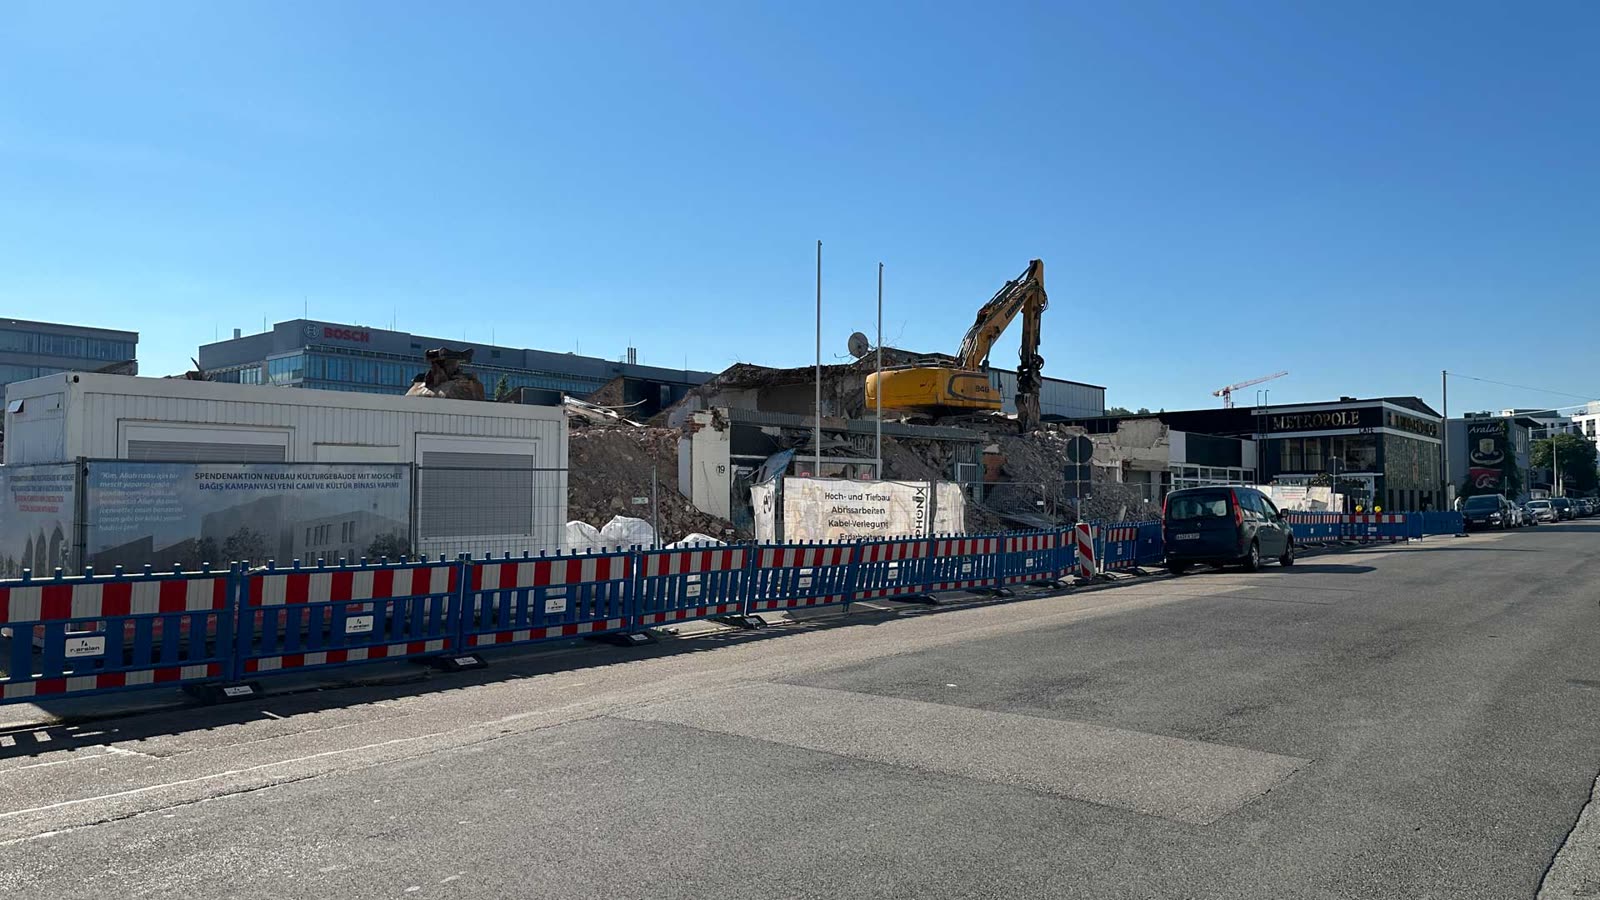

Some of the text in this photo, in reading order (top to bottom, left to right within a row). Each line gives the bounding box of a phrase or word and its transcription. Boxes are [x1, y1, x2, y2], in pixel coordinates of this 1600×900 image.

[323, 327, 369, 342] BOSCH
[1273, 411, 1360, 430] METROPOLE
[717, 465, 726, 474] 19
[194, 472, 262, 480] SPENDENAKTION
[824, 492, 890, 502] Hoch- und Tiefbau
[831, 506, 885, 515] Abrissarbeiten
